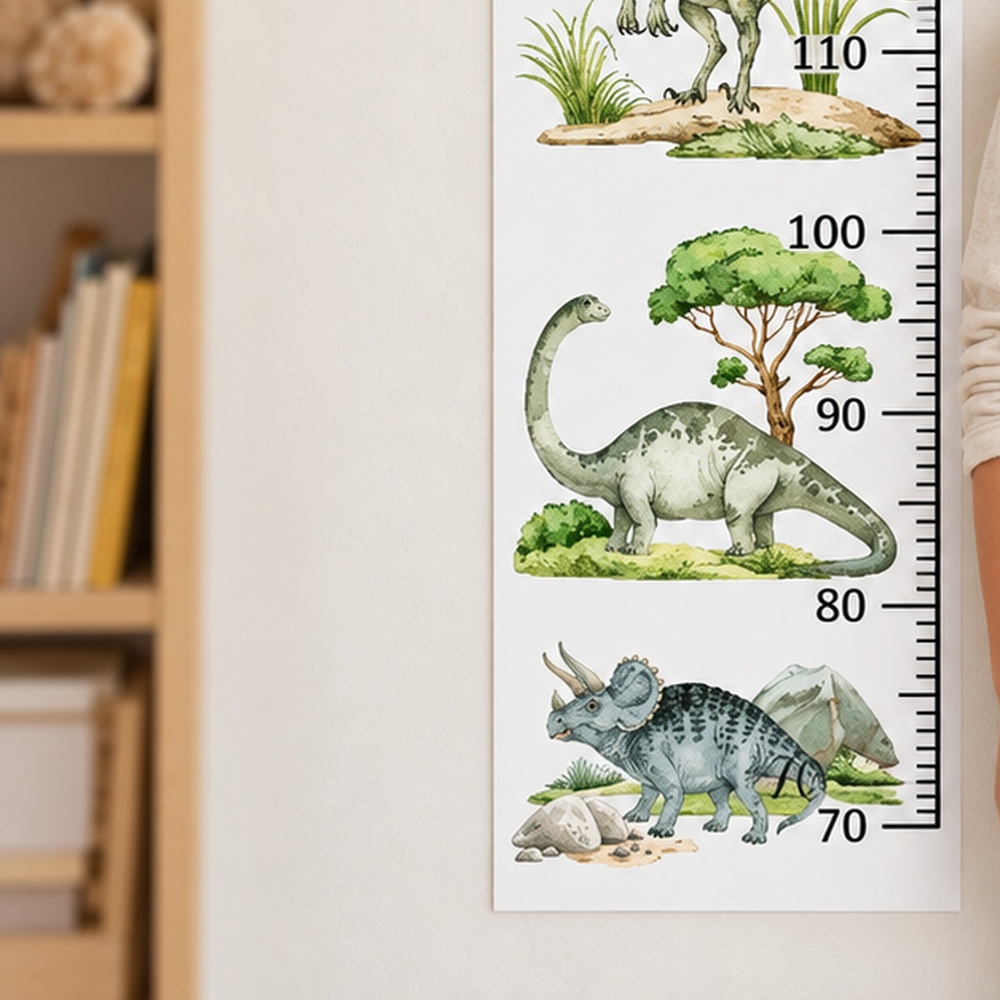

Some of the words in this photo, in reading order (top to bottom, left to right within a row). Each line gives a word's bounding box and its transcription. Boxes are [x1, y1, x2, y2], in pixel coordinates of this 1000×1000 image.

[793, 36, 867, 70] 110
[789, 215, 865, 249] 100
[816, 398, 866, 432] 90
[816, 589, 866, 623] 80
[818, 809, 867, 843] 70
